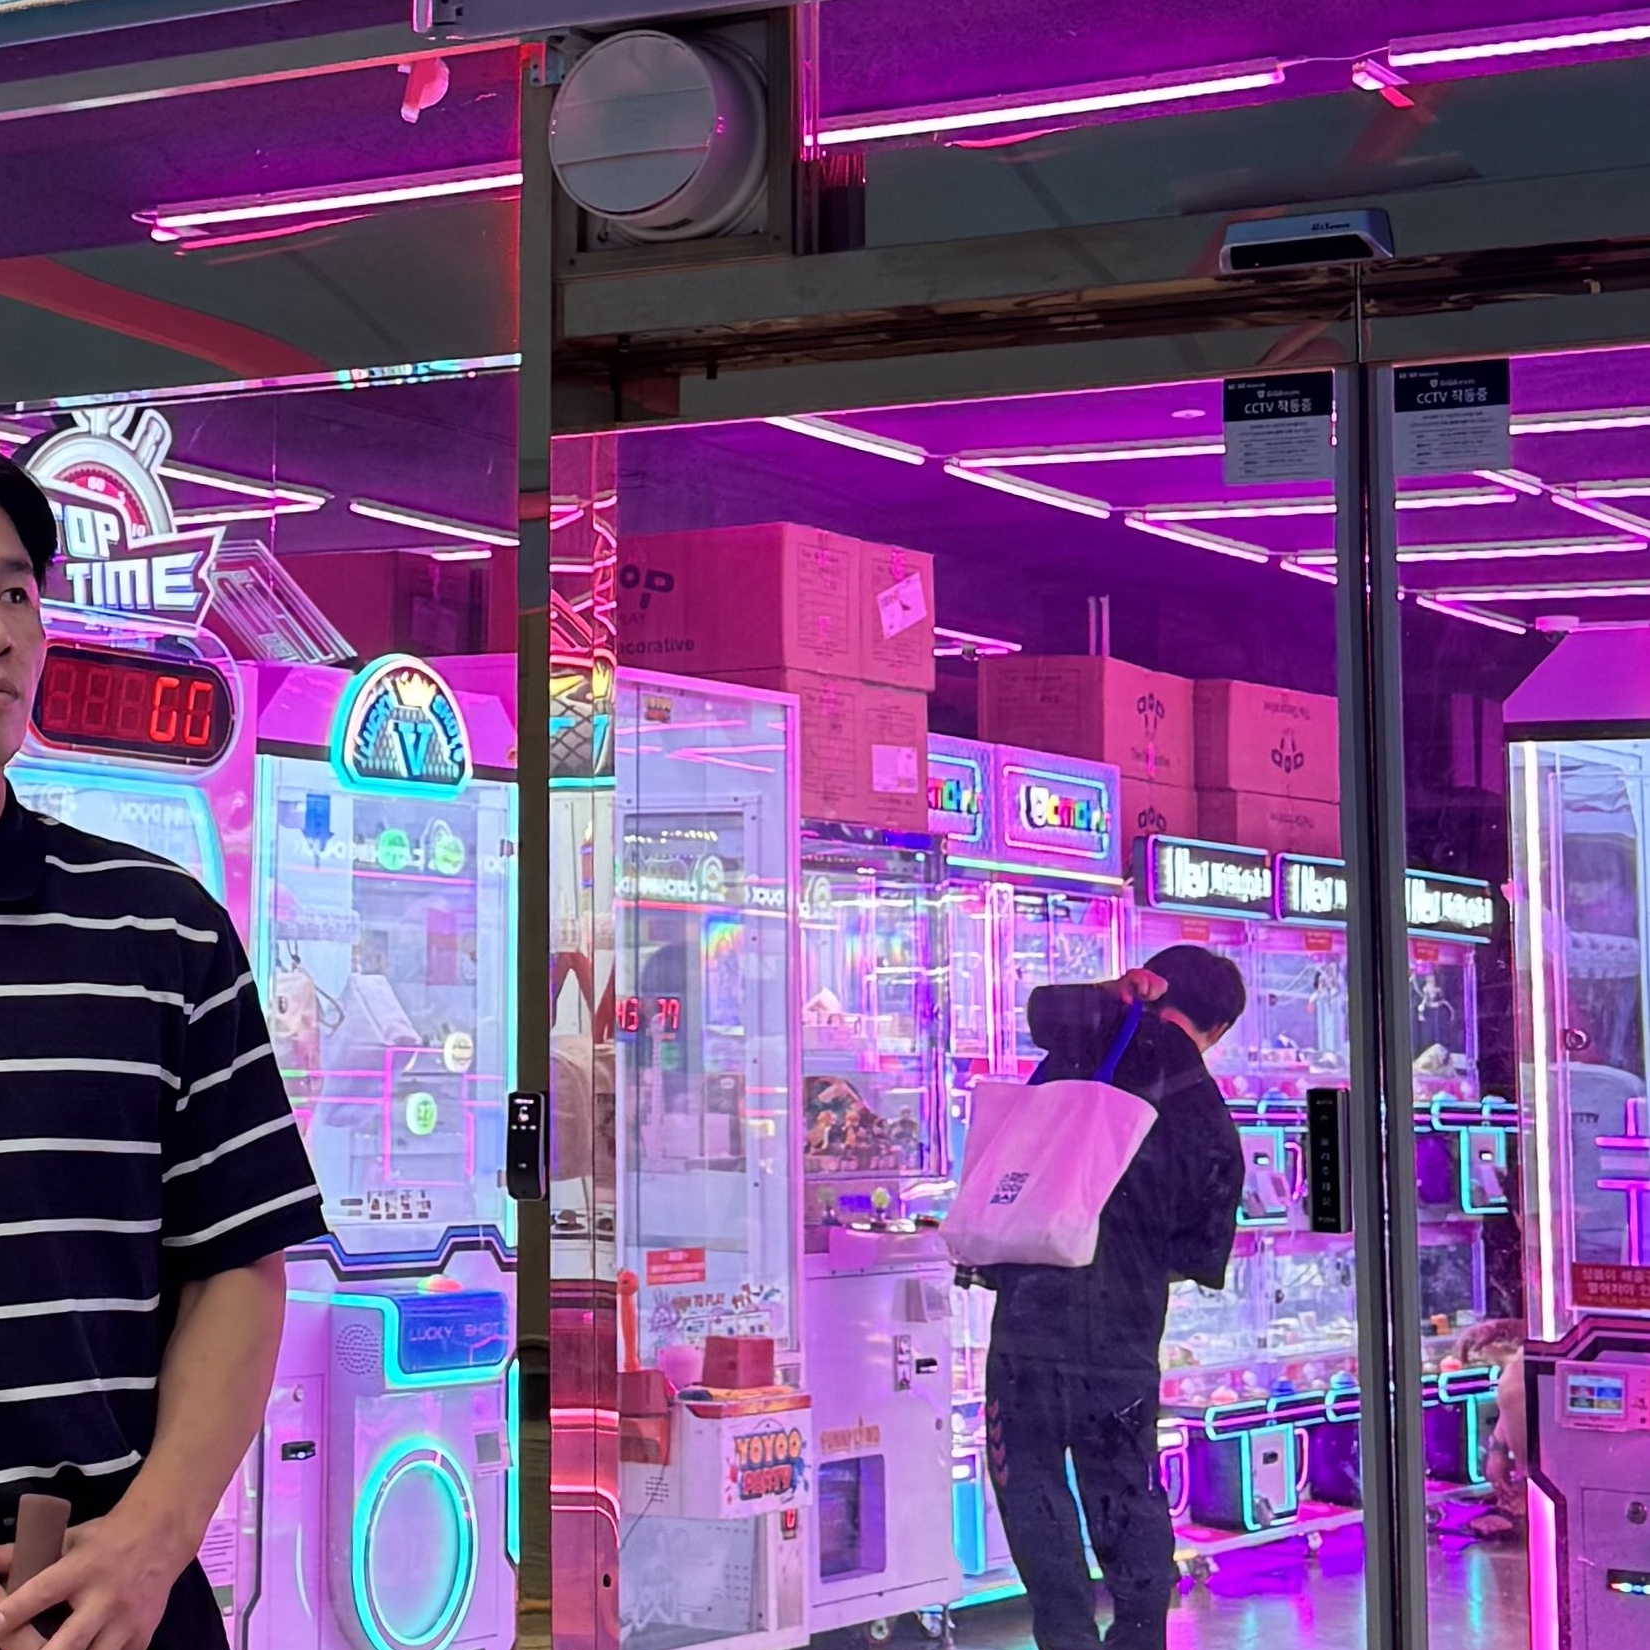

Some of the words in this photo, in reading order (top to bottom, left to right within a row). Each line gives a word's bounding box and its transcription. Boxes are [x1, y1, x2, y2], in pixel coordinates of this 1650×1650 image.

[1416, 391, 1448, 405] CCTV
[1451, 386, 1488, 403] 작동중
[1244, 401, 1274, 414] CCTV
[1277, 397, 1312, 413] 작동중
[49, 500, 120, 560] OP
[66, 551, 204, 612] TIME
[618, 636, 695, 655] corative
[408, 1325, 454, 1342] LUCKY
